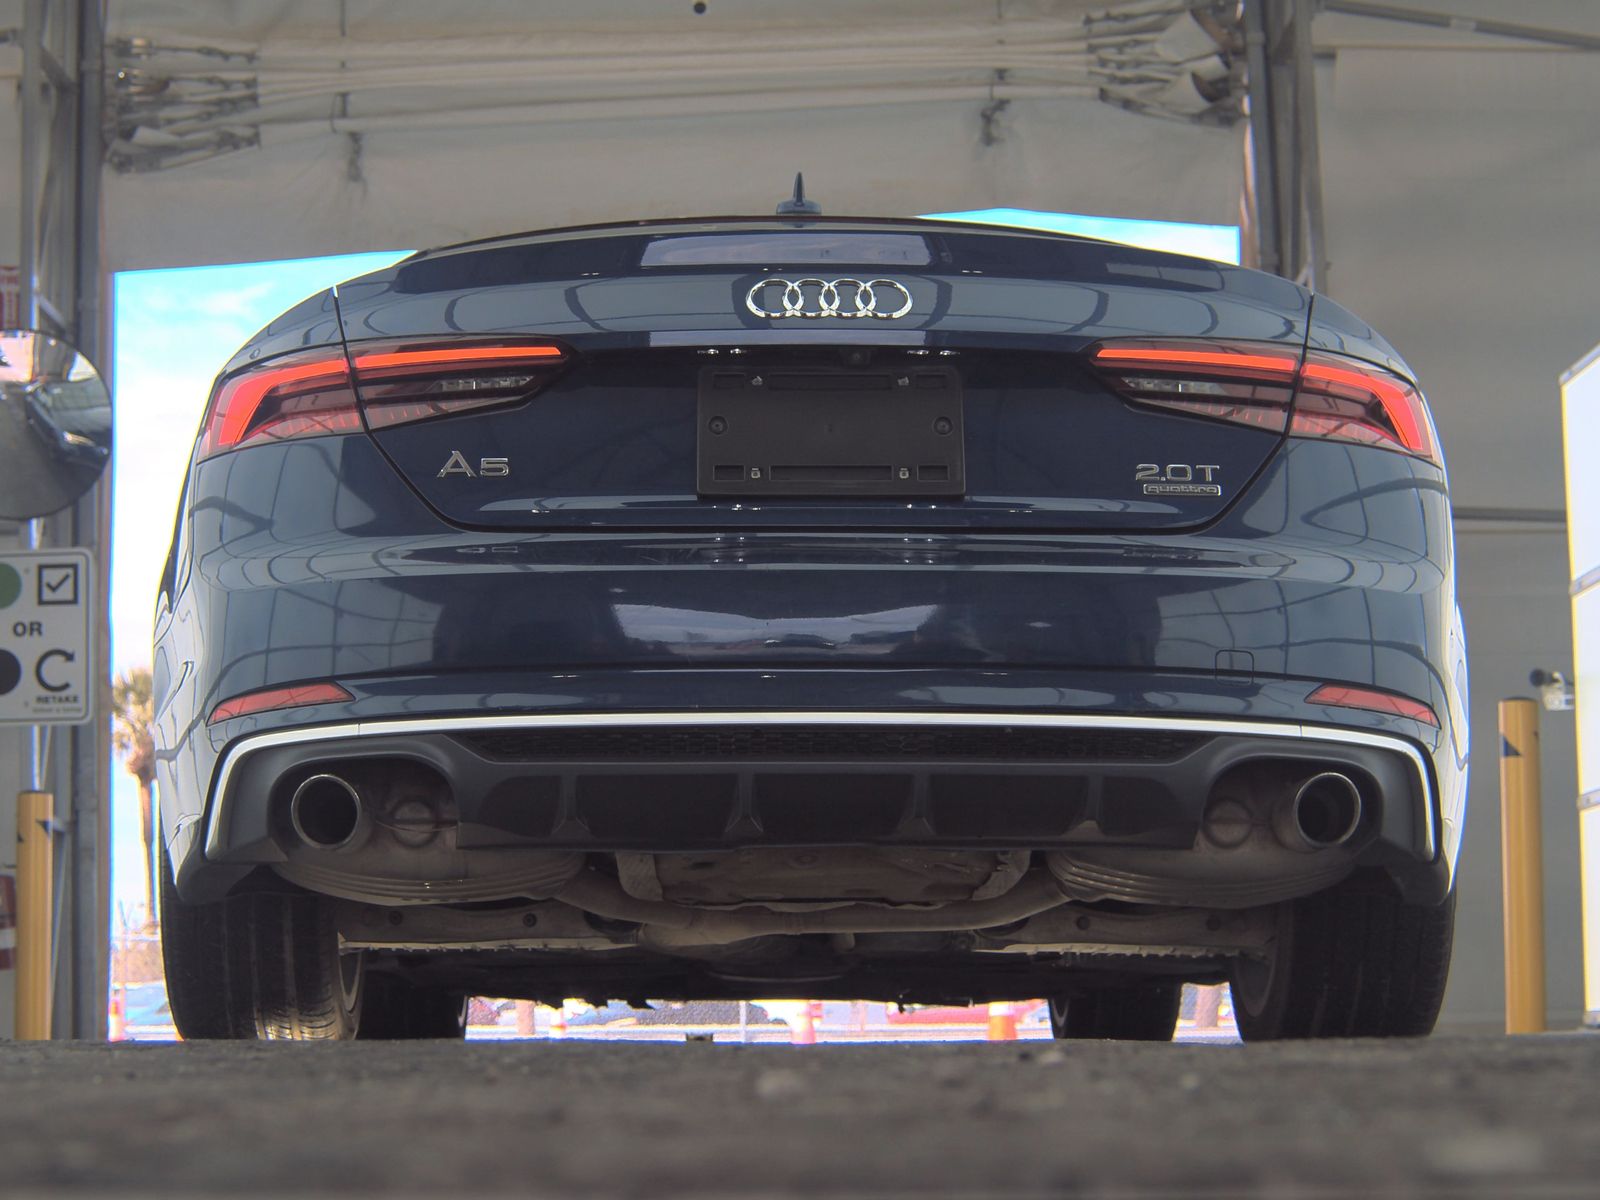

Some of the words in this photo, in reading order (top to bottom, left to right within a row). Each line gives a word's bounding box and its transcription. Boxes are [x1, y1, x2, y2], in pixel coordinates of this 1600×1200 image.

[437, 451, 509, 477] A5
[1135, 463, 1220, 481] 2.0T
[1145, 484, 1219, 495] quattro
[12, 621, 43, 637] OR
